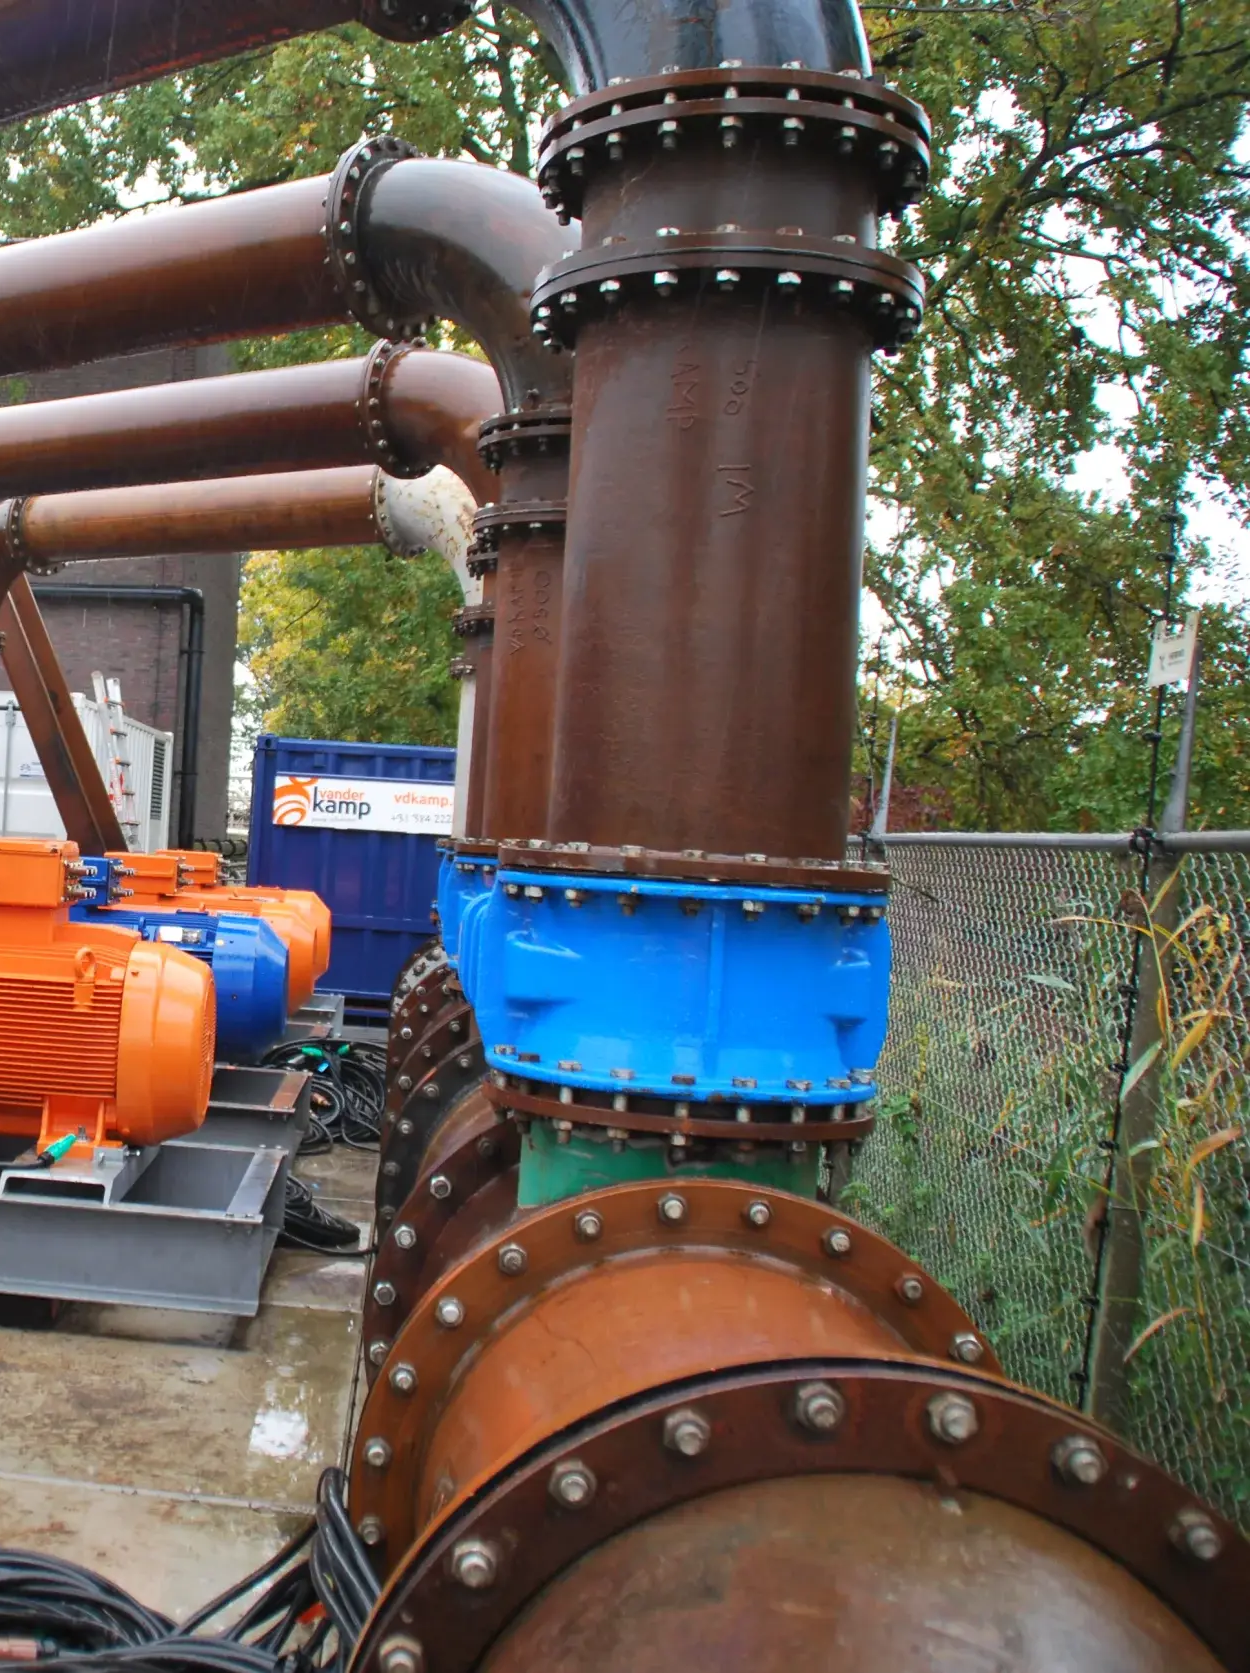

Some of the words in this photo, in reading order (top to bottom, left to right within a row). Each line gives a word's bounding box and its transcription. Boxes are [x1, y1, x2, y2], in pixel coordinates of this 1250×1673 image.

[312, 785, 372, 820] kamp
[319, 787, 366, 801] vander
[393, 791, 453, 808] vdkamp.
